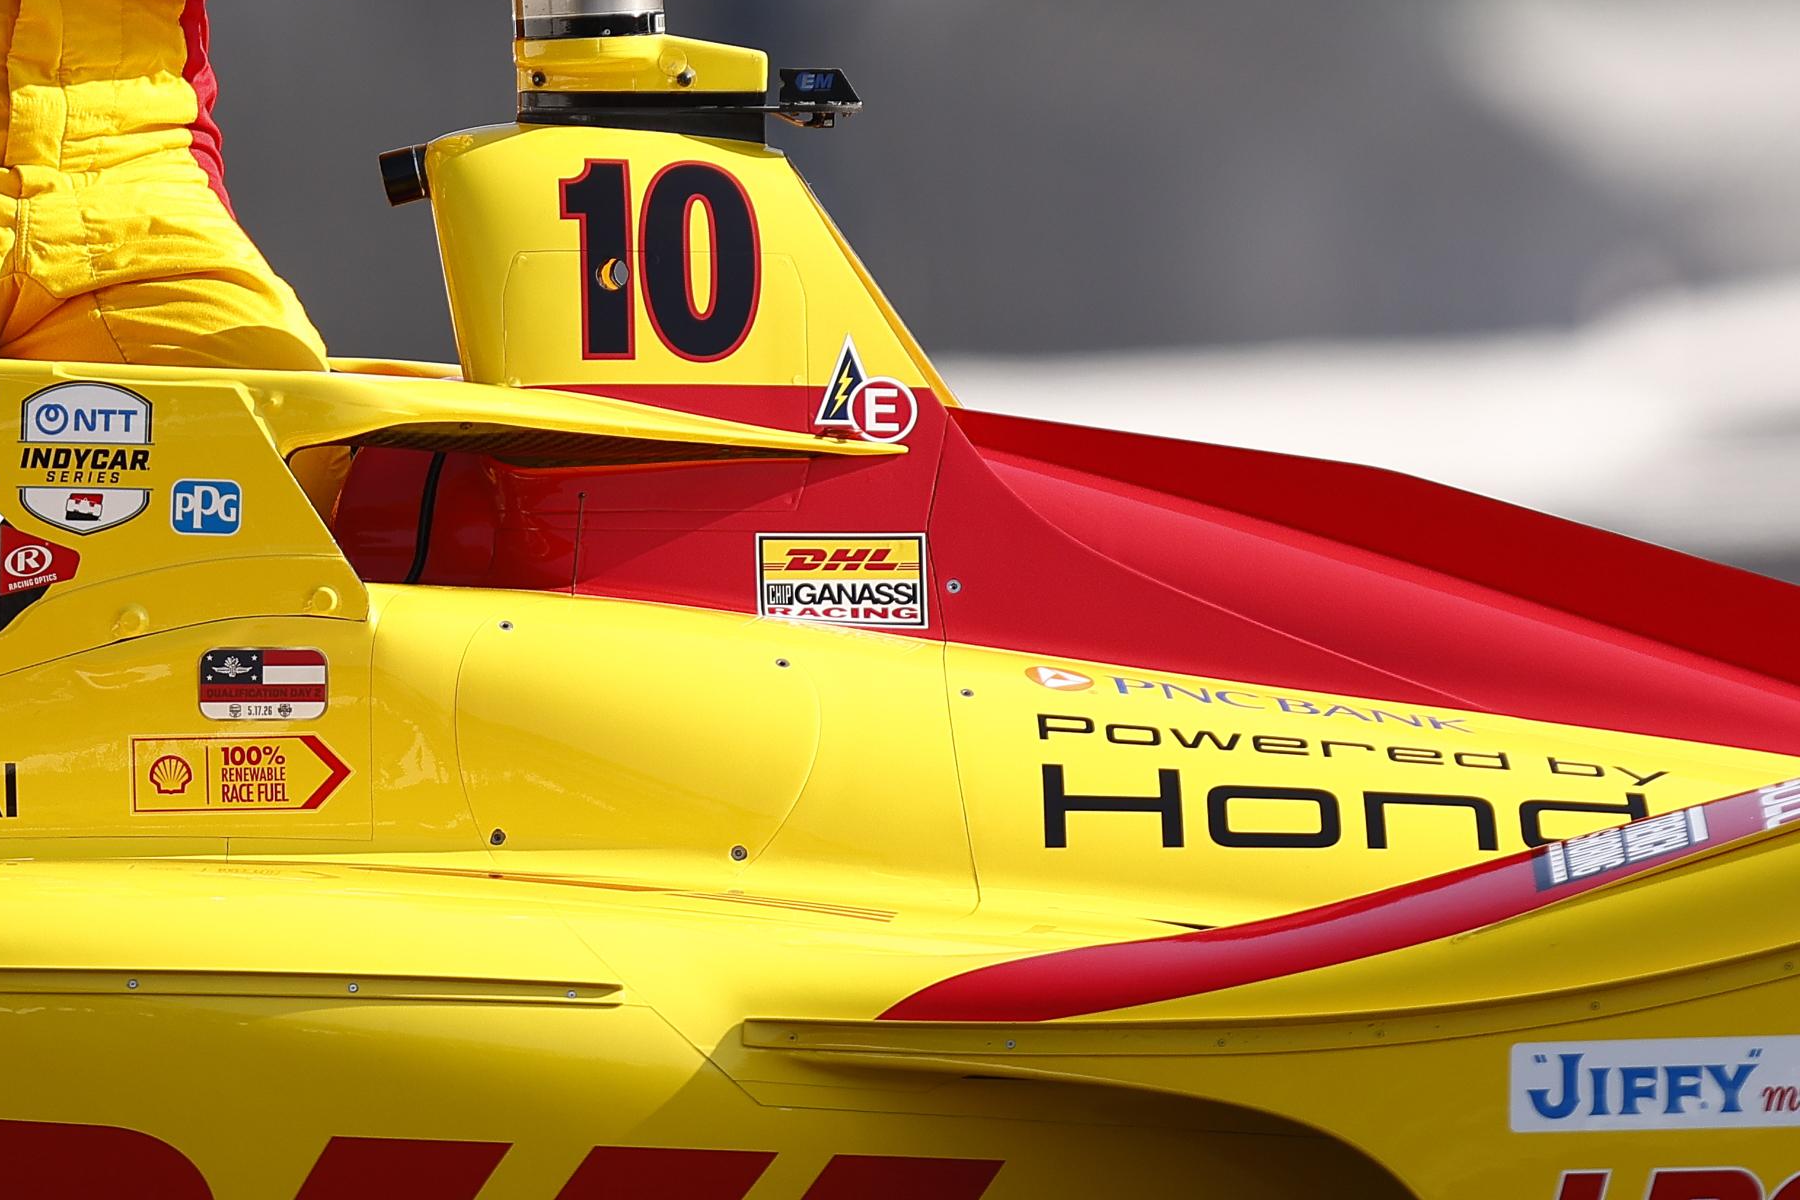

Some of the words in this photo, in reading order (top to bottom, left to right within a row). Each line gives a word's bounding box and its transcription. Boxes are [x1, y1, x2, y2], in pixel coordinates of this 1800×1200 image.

[558, 157, 762, 364] 10
[865, 389, 899, 430] E
[74, 410, 137, 432] NTT
[19, 449, 150, 471] INDYCAR
[45, 471, 121, 484] SERIES
[175, 486, 238, 529] PPG
[784, 549, 899, 571] DHL
[8, 579, 34, 591] RACING
[34, 573, 58, 585] OPTICS
[768, 585, 792, 604] CHIP
[794, 583, 918, 605] GANASSI
[767, 607, 919, 619] RACING
[207, 688, 289, 698] QUALIFICATION
[291, 688, 312, 697] DAY
[313, 688, 323, 697] 2
[247, 706, 273, 716] 5.17.26
[1109, 676, 1270, 710] PNC
[1275, 697, 1476, 734] BANK
[221, 745, 285, 766] 100%
[1037, 713, 1511, 770] Powered
[1546, 756, 1670, 786] by
[221, 767, 286, 782] RENEWABLE
[222, 784, 254, 802] RACE
[258, 783, 289, 802] FUEL
[1043, 763, 1649, 852] Hond
